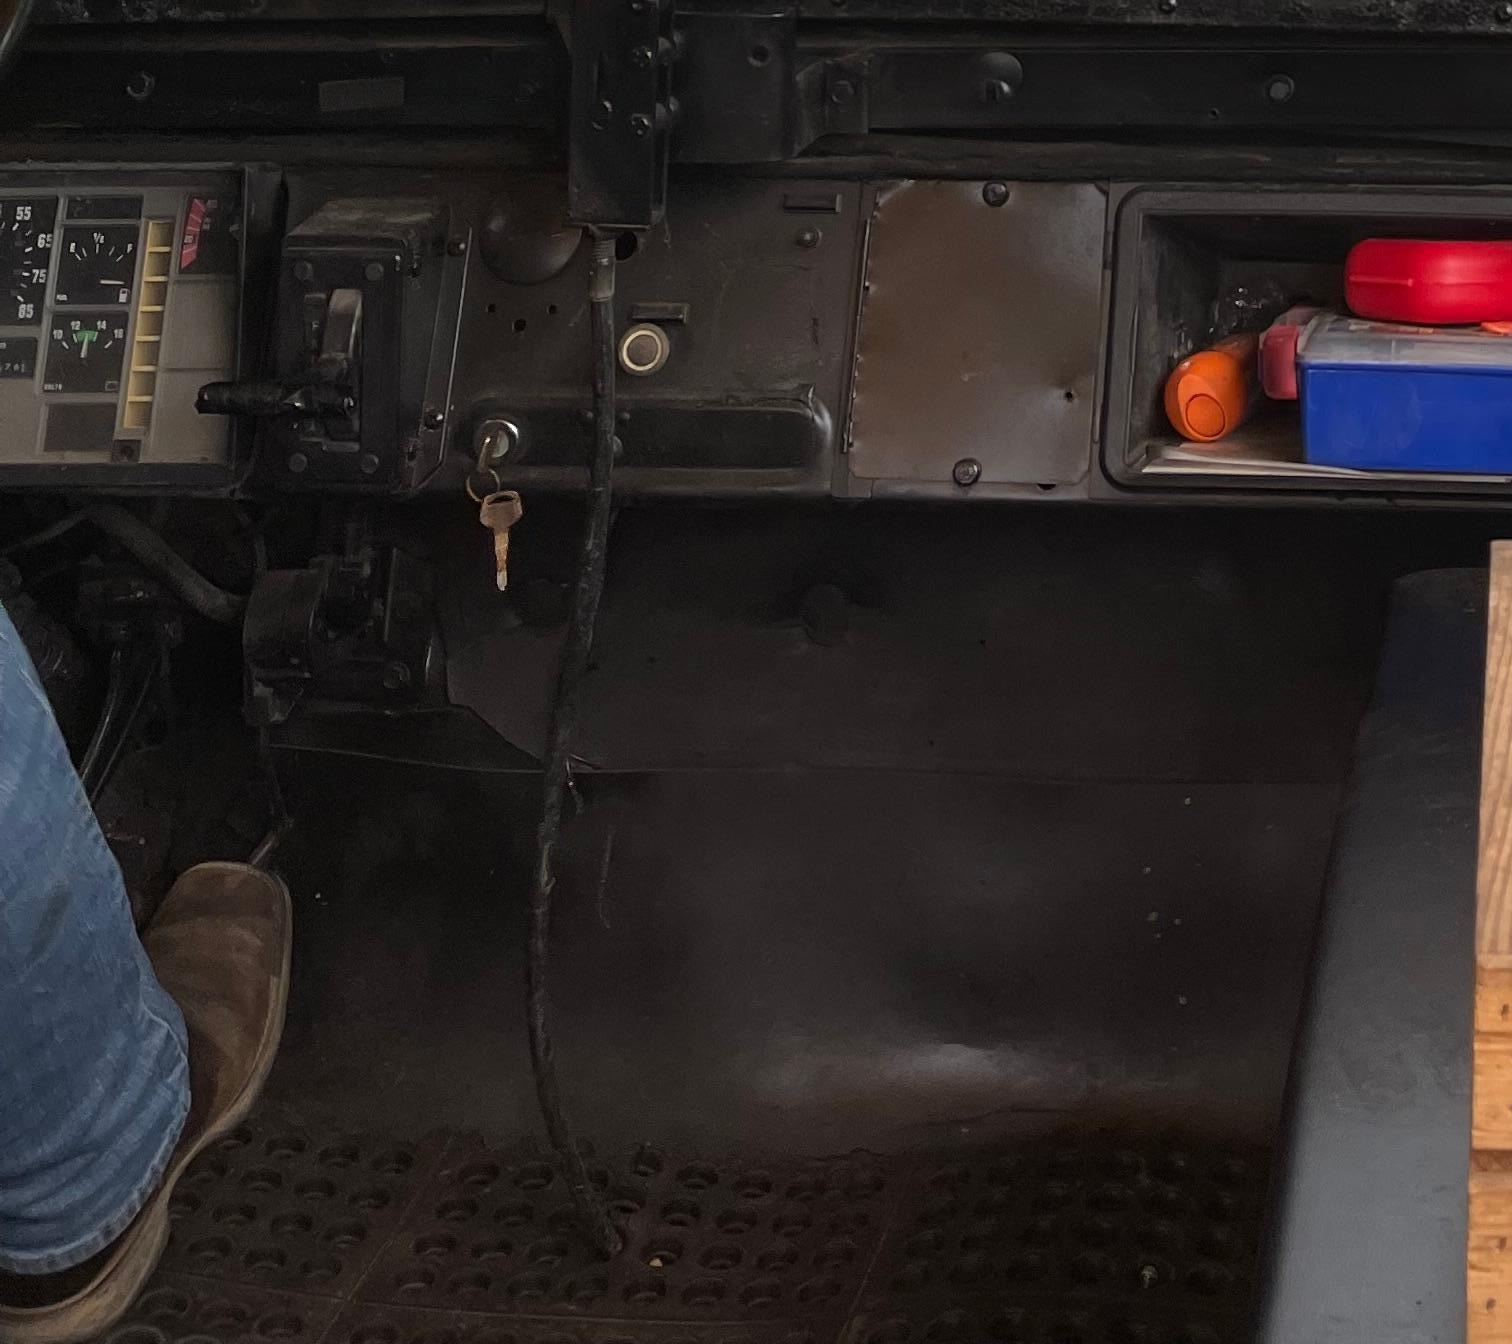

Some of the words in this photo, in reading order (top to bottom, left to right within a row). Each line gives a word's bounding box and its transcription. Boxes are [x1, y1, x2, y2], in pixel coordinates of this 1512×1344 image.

[16, 206, 32, 221] 55
[37, 233, 52, 249] 65
[32, 269, 47, 284] 75
